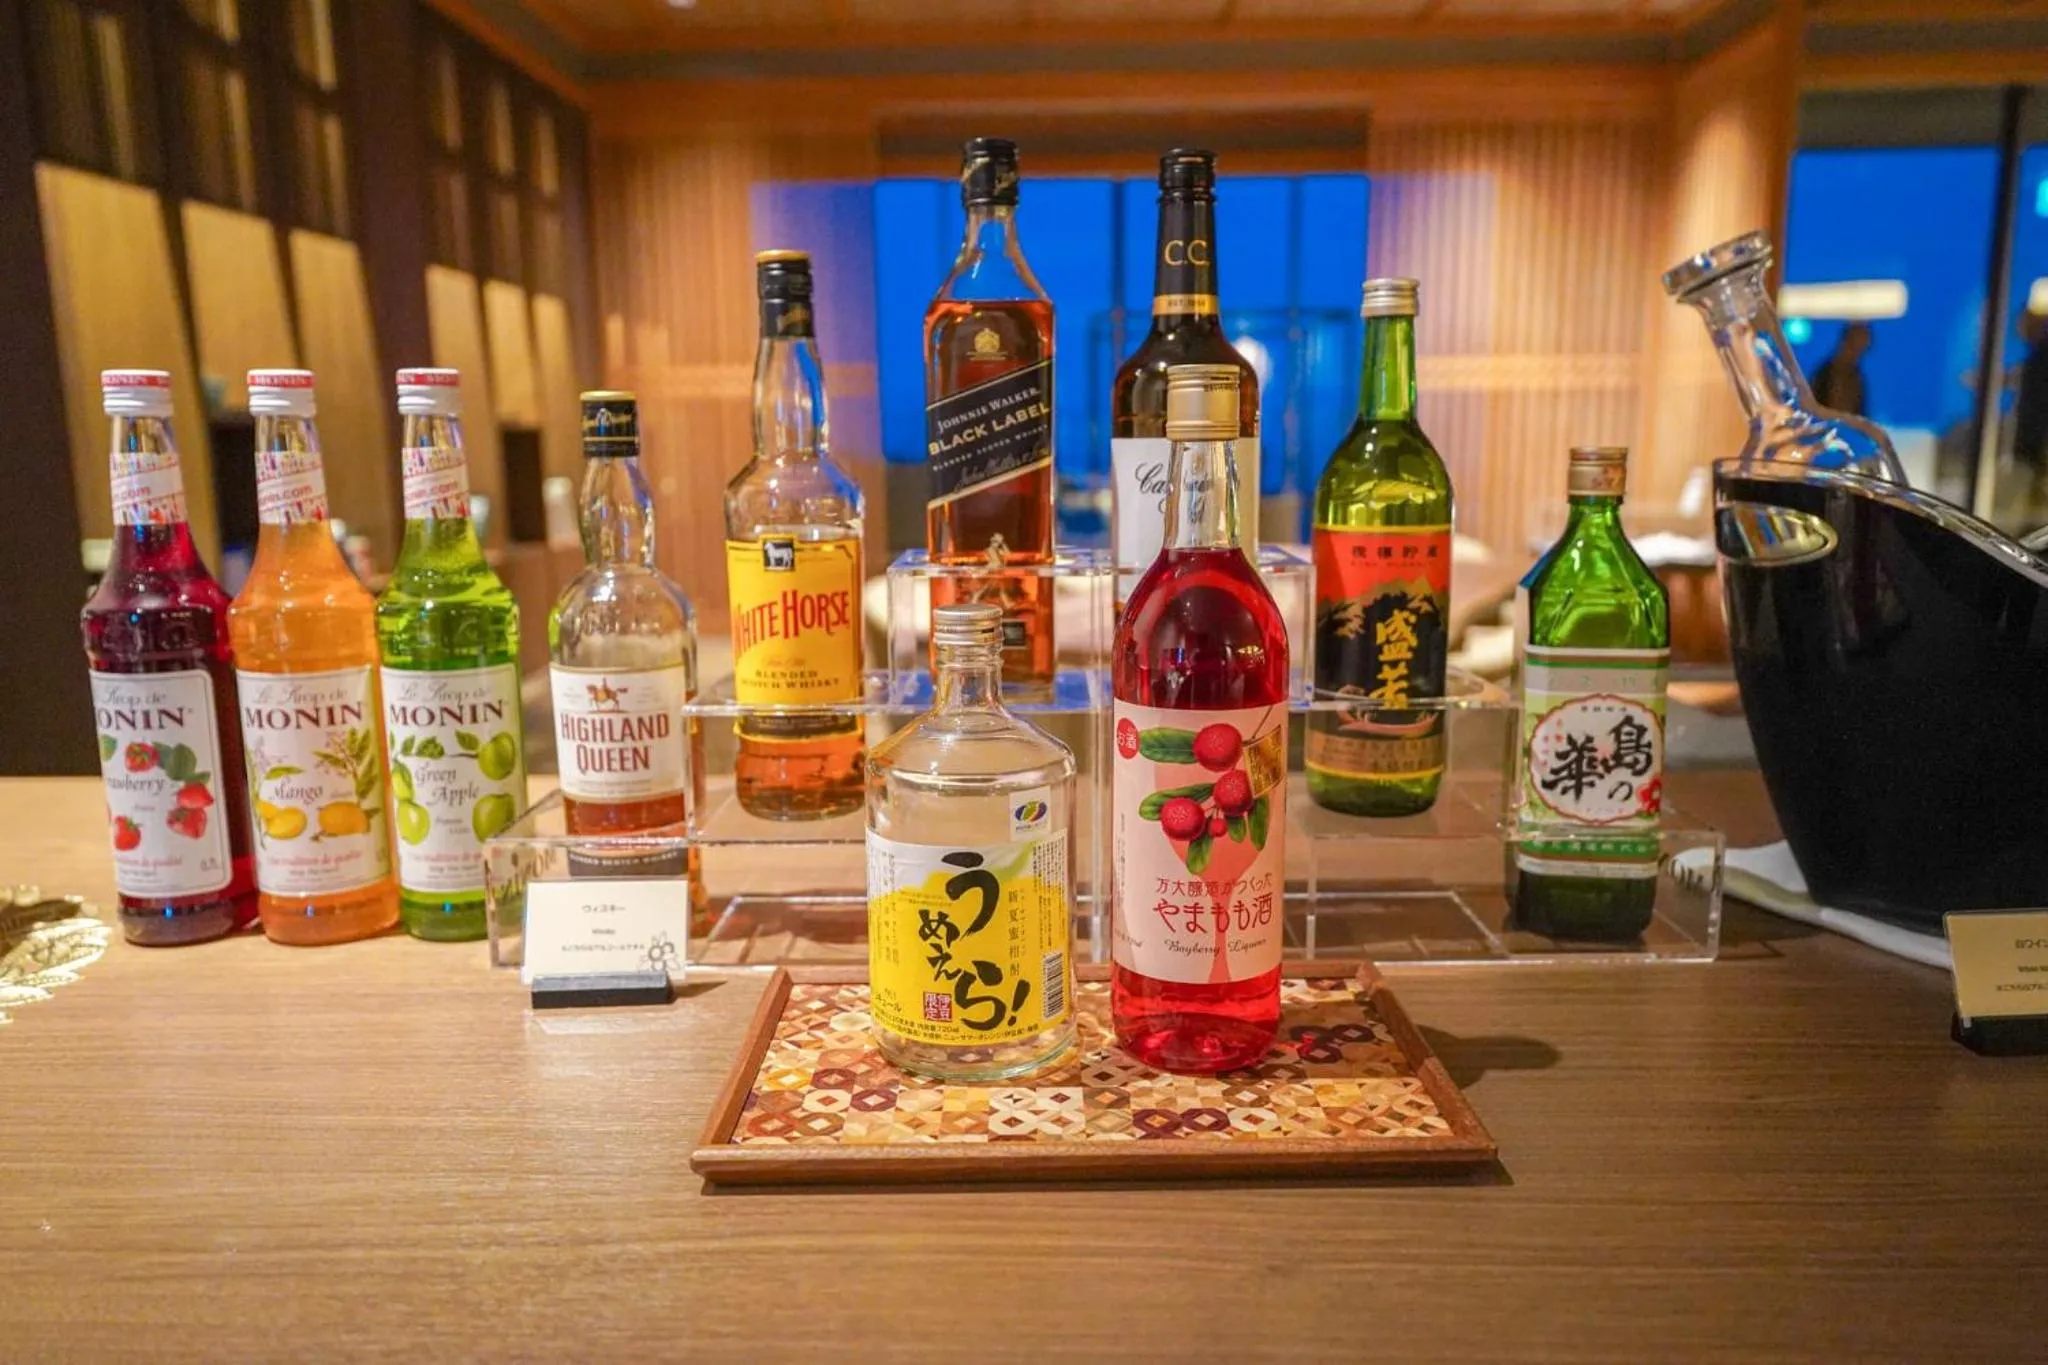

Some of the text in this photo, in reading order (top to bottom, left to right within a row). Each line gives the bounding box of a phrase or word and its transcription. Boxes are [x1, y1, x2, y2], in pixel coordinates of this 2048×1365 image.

[938, 386, 1040, 434] JOHNNIE WALKER
[928, 402, 1050, 456] BLACK LABEL
[732, 590, 850, 665] WHITE HORSE
[245, 701, 363, 730] MONIN
[389, 699, 505, 728] MONIN
[560, 712, 670, 743] HIGHLAND
[575, 743, 650, 775] QUEEN
[426, 780, 479, 807] Apple
[1152, 892, 1273, 934] やまもも酒
